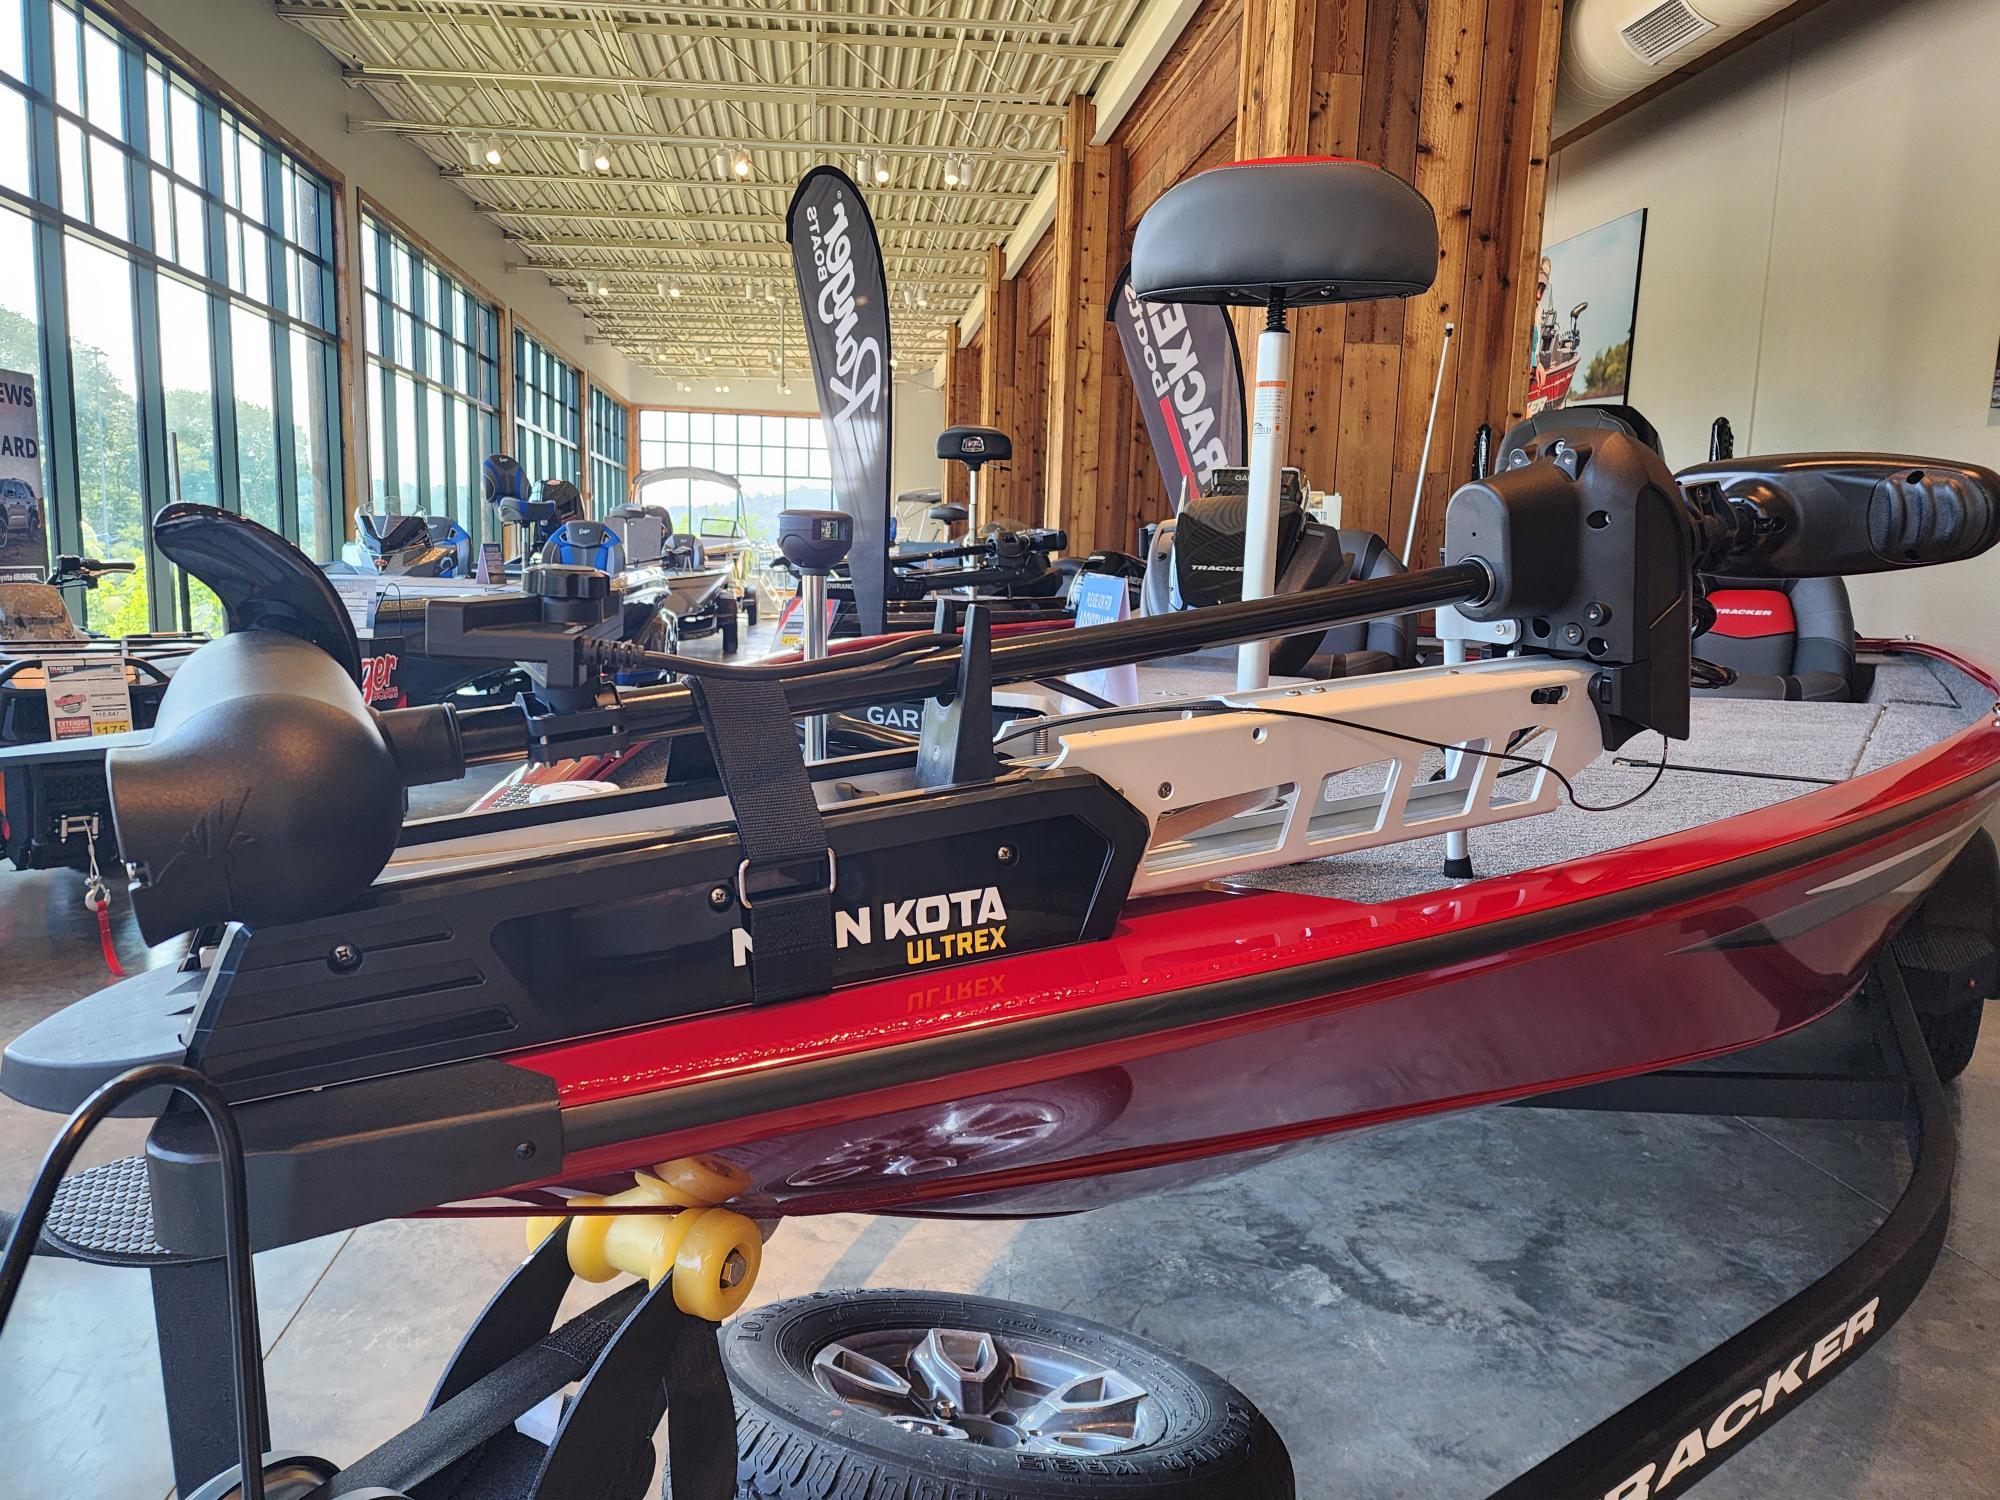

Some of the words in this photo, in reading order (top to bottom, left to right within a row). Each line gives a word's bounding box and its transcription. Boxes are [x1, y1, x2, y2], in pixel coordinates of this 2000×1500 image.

[1191, 564, 1245, 572] TRACKE
[1716, 608, 1773, 616] TRACKER
[883, 886, 1008, 941] KOTA
[906, 925, 1008, 966] ULTREX
